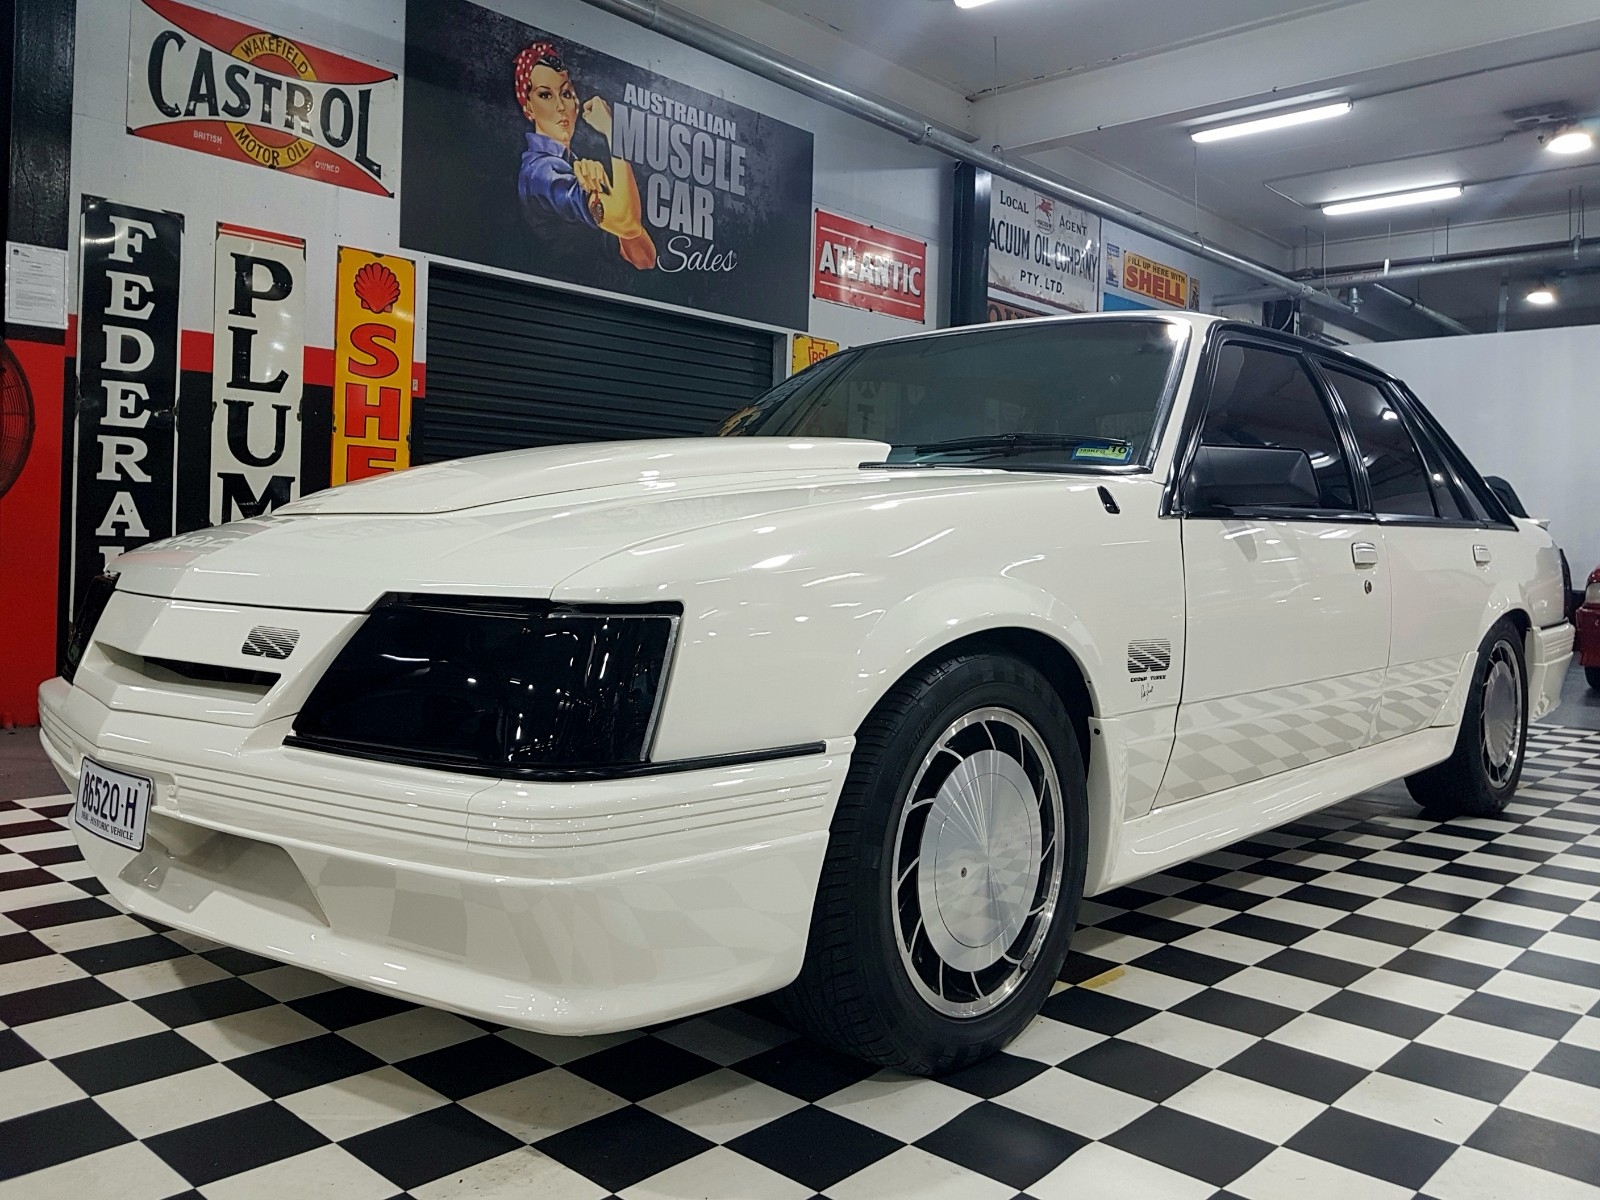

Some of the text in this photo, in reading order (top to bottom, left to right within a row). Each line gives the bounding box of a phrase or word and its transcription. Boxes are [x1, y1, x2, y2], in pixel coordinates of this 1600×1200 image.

[241, 35, 309, 76] WAKEFIELD
[147, 30, 382, 180] CASTROL
[623, 82, 737, 142] AUSTRALIAN
[193, 130, 340, 174] BRITISH OWNED
[234, 129, 308, 166] MOTOR OIL
[611, 101, 746, 197] MUSCLE
[647, 173, 714, 240] CAR
[1000, 190, 1029, 214] LOCAL
[1060, 215, 1088, 236] AGENT
[656, 235, 738, 273] Sales
[818, 240, 922, 297] ATLANTIC
[1034, 233, 1051, 267] OIL
[1055, 241, 1098, 283] COMPANY
[1127, 255, 1186, 284] FILL UP HERE WITH
[1045, 277, 1065, 294] LTD.
[1125, 265, 1185, 306] SHELL
[110, 825, 134, 841] VEHICLE
